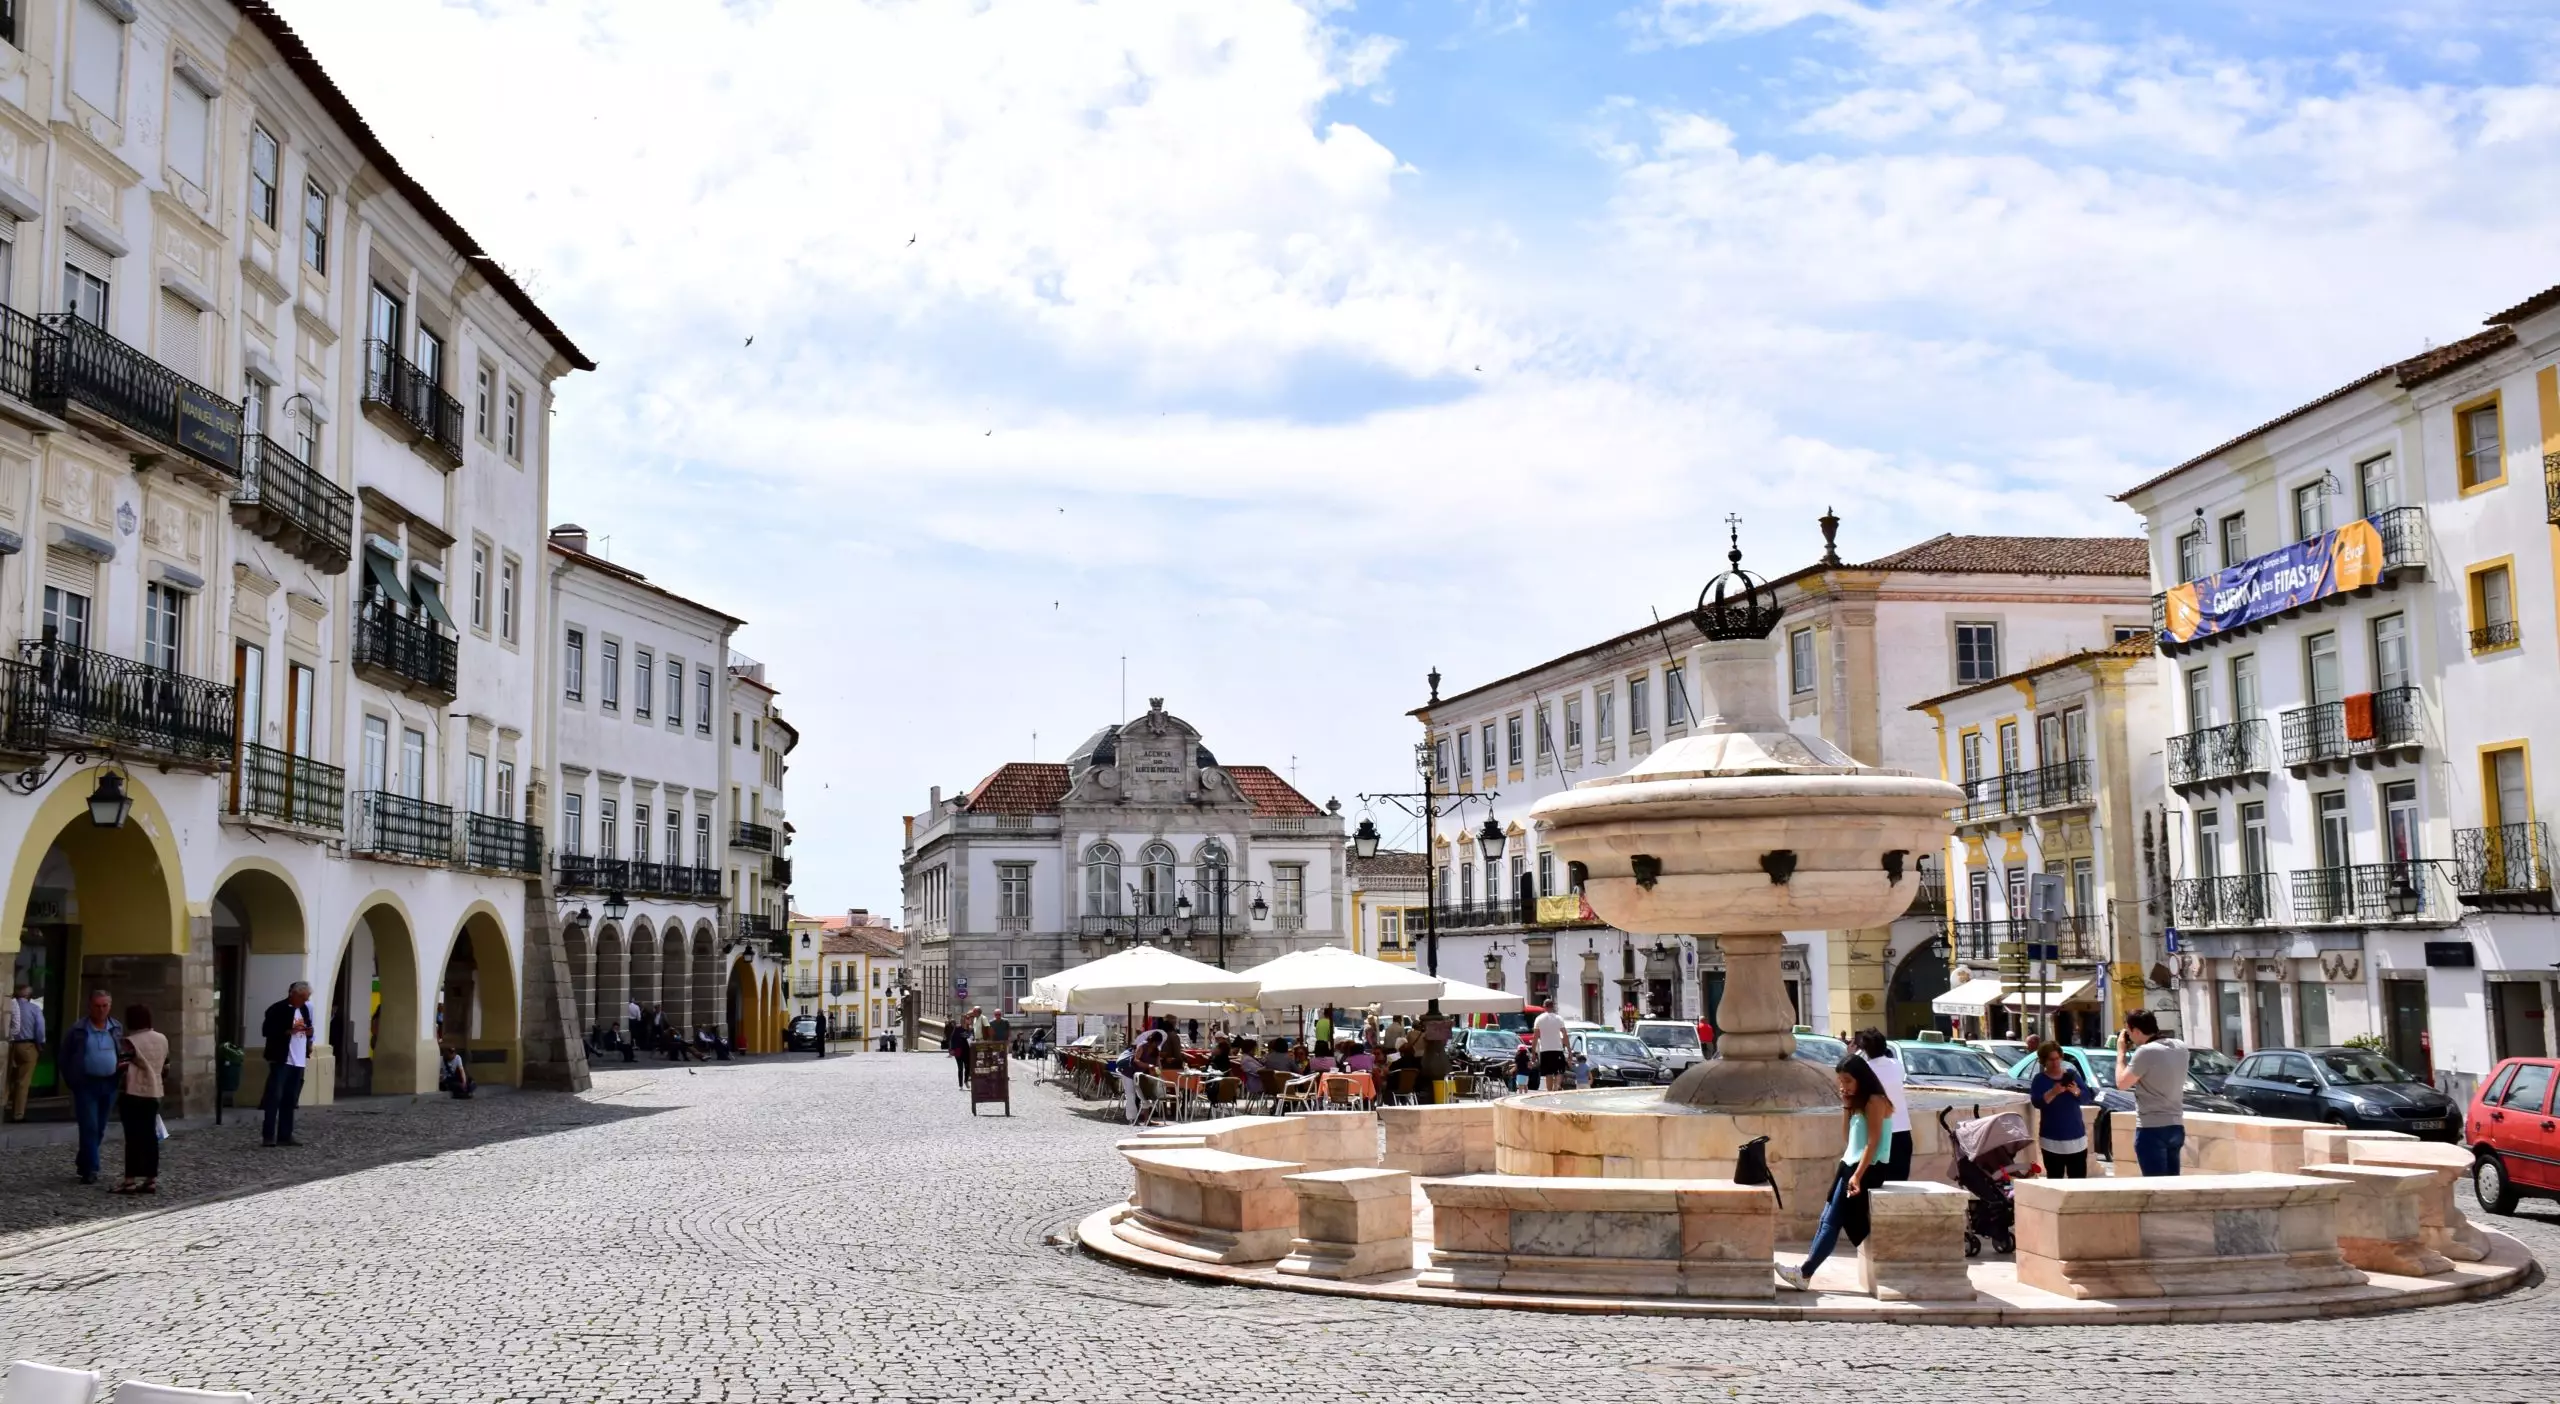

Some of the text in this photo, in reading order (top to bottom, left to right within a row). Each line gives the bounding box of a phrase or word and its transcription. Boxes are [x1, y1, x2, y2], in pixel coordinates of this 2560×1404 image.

[182, 400, 214, 427] MANUEL
[2274, 564, 2306, 595] FITAS
[2097, 964, 2104, 986] P
